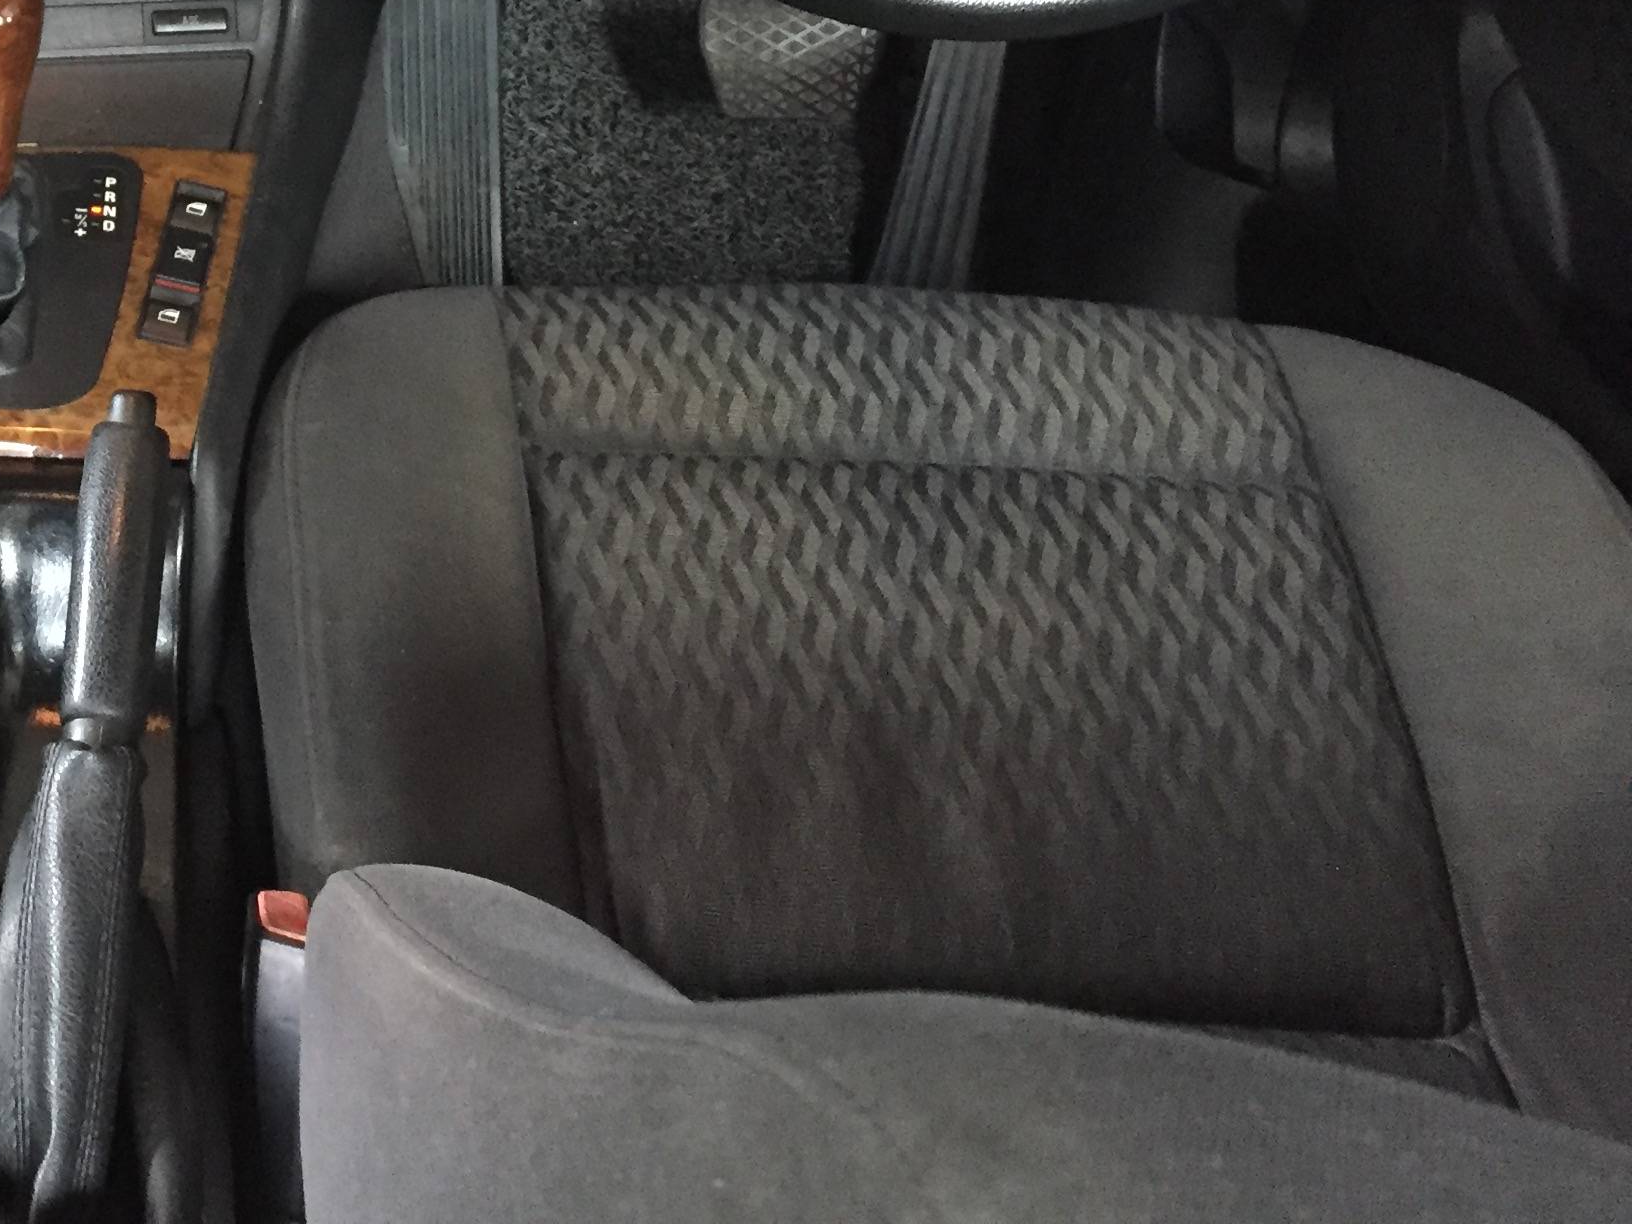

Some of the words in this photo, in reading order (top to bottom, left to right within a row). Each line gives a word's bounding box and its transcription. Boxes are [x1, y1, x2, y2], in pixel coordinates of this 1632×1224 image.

[105, 176, 117, 188] P
[104, 190, 116, 203] R
[103, 205, 117, 217] N
[102, 219, 116, 232] D
